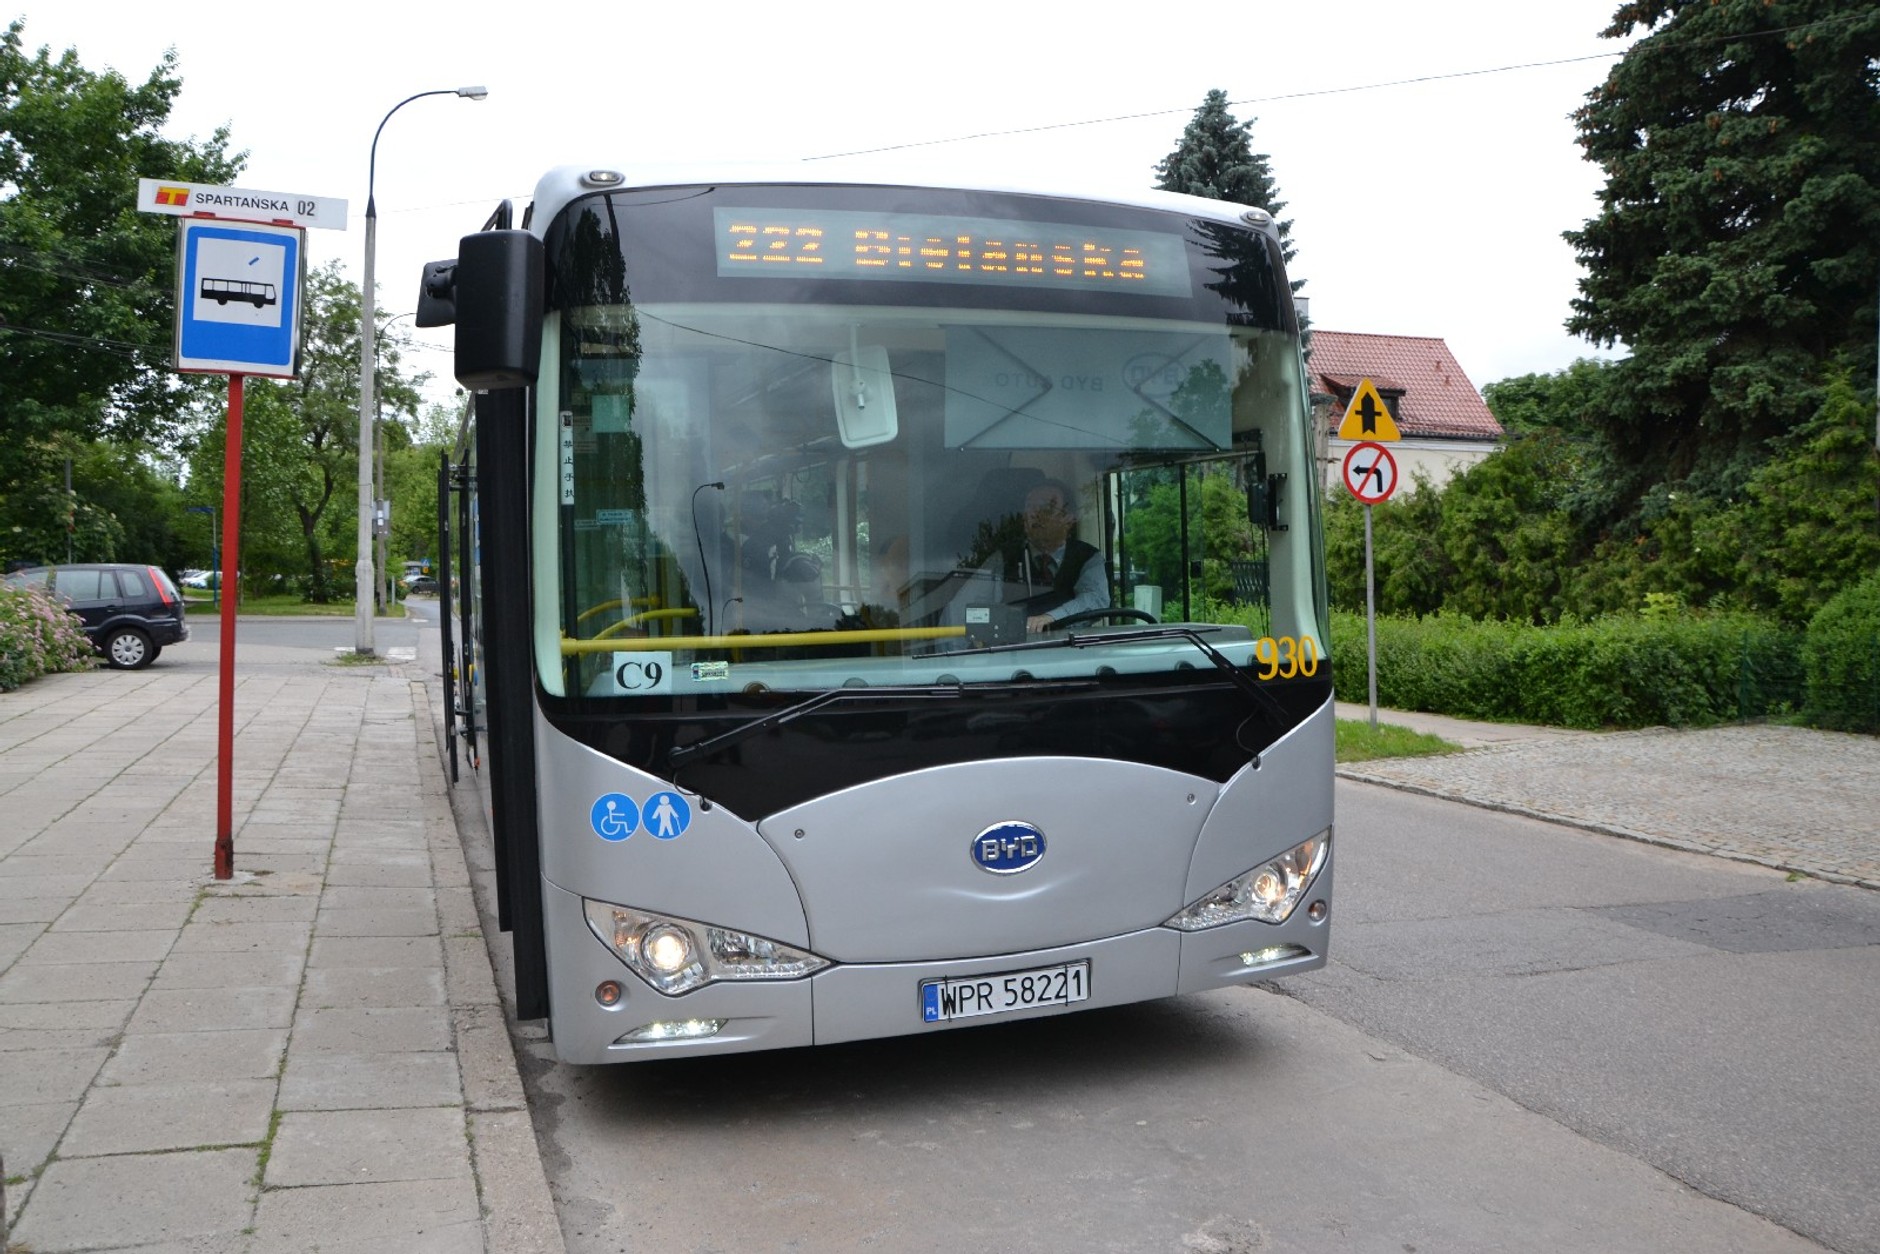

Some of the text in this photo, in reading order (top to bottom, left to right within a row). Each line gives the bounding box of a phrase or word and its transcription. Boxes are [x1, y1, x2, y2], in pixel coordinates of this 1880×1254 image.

[195, 193, 289, 212] SPARTAŃSKA
[296, 200, 316, 217] 02
[729, 224, 823, 264] 222
[1256, 635, 1318, 680] 930
[616, 661, 663, 690] C9
[981, 835, 1038, 861] BYD
[926, 969, 1082, 1016] PL WPR 58221
